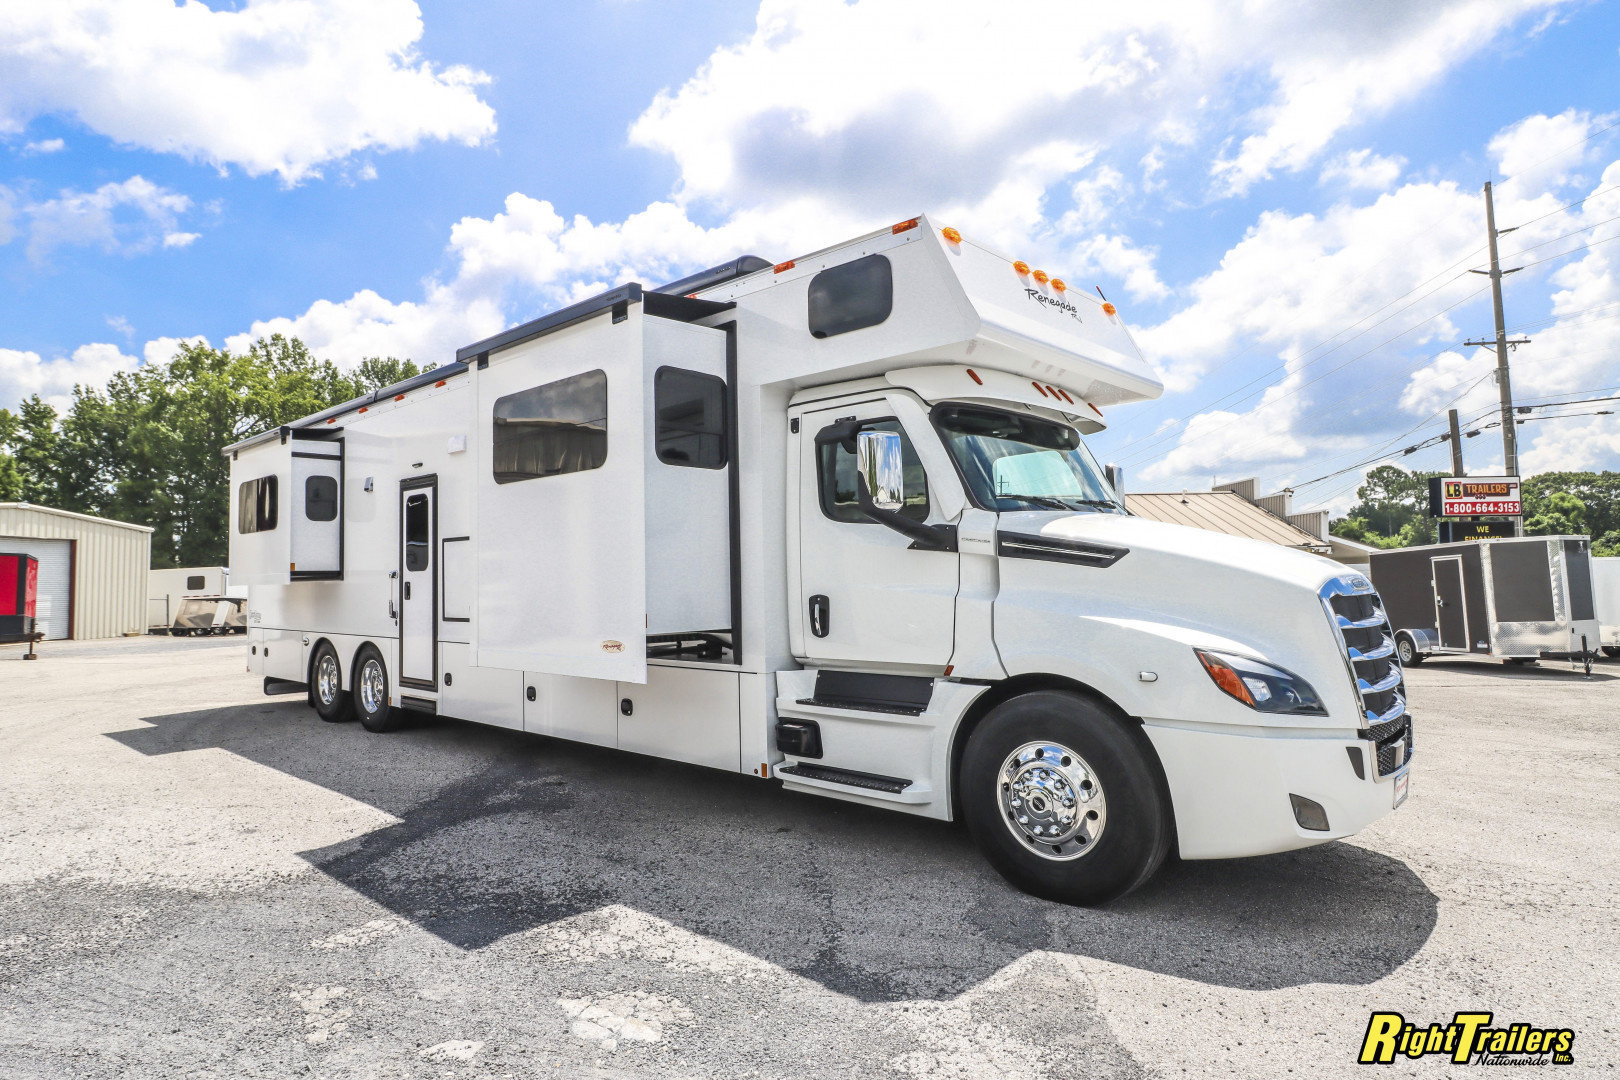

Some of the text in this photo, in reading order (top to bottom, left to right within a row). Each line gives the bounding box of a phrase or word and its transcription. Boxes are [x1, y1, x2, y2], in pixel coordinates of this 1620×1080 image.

[1023, 287, 1078, 314] Renegade
[1446, 483, 1507, 497] LB TRAILERS
[1445, 503, 1519, 513] 1-800-664-3153
[1476, 525, 1490, 533] WE
